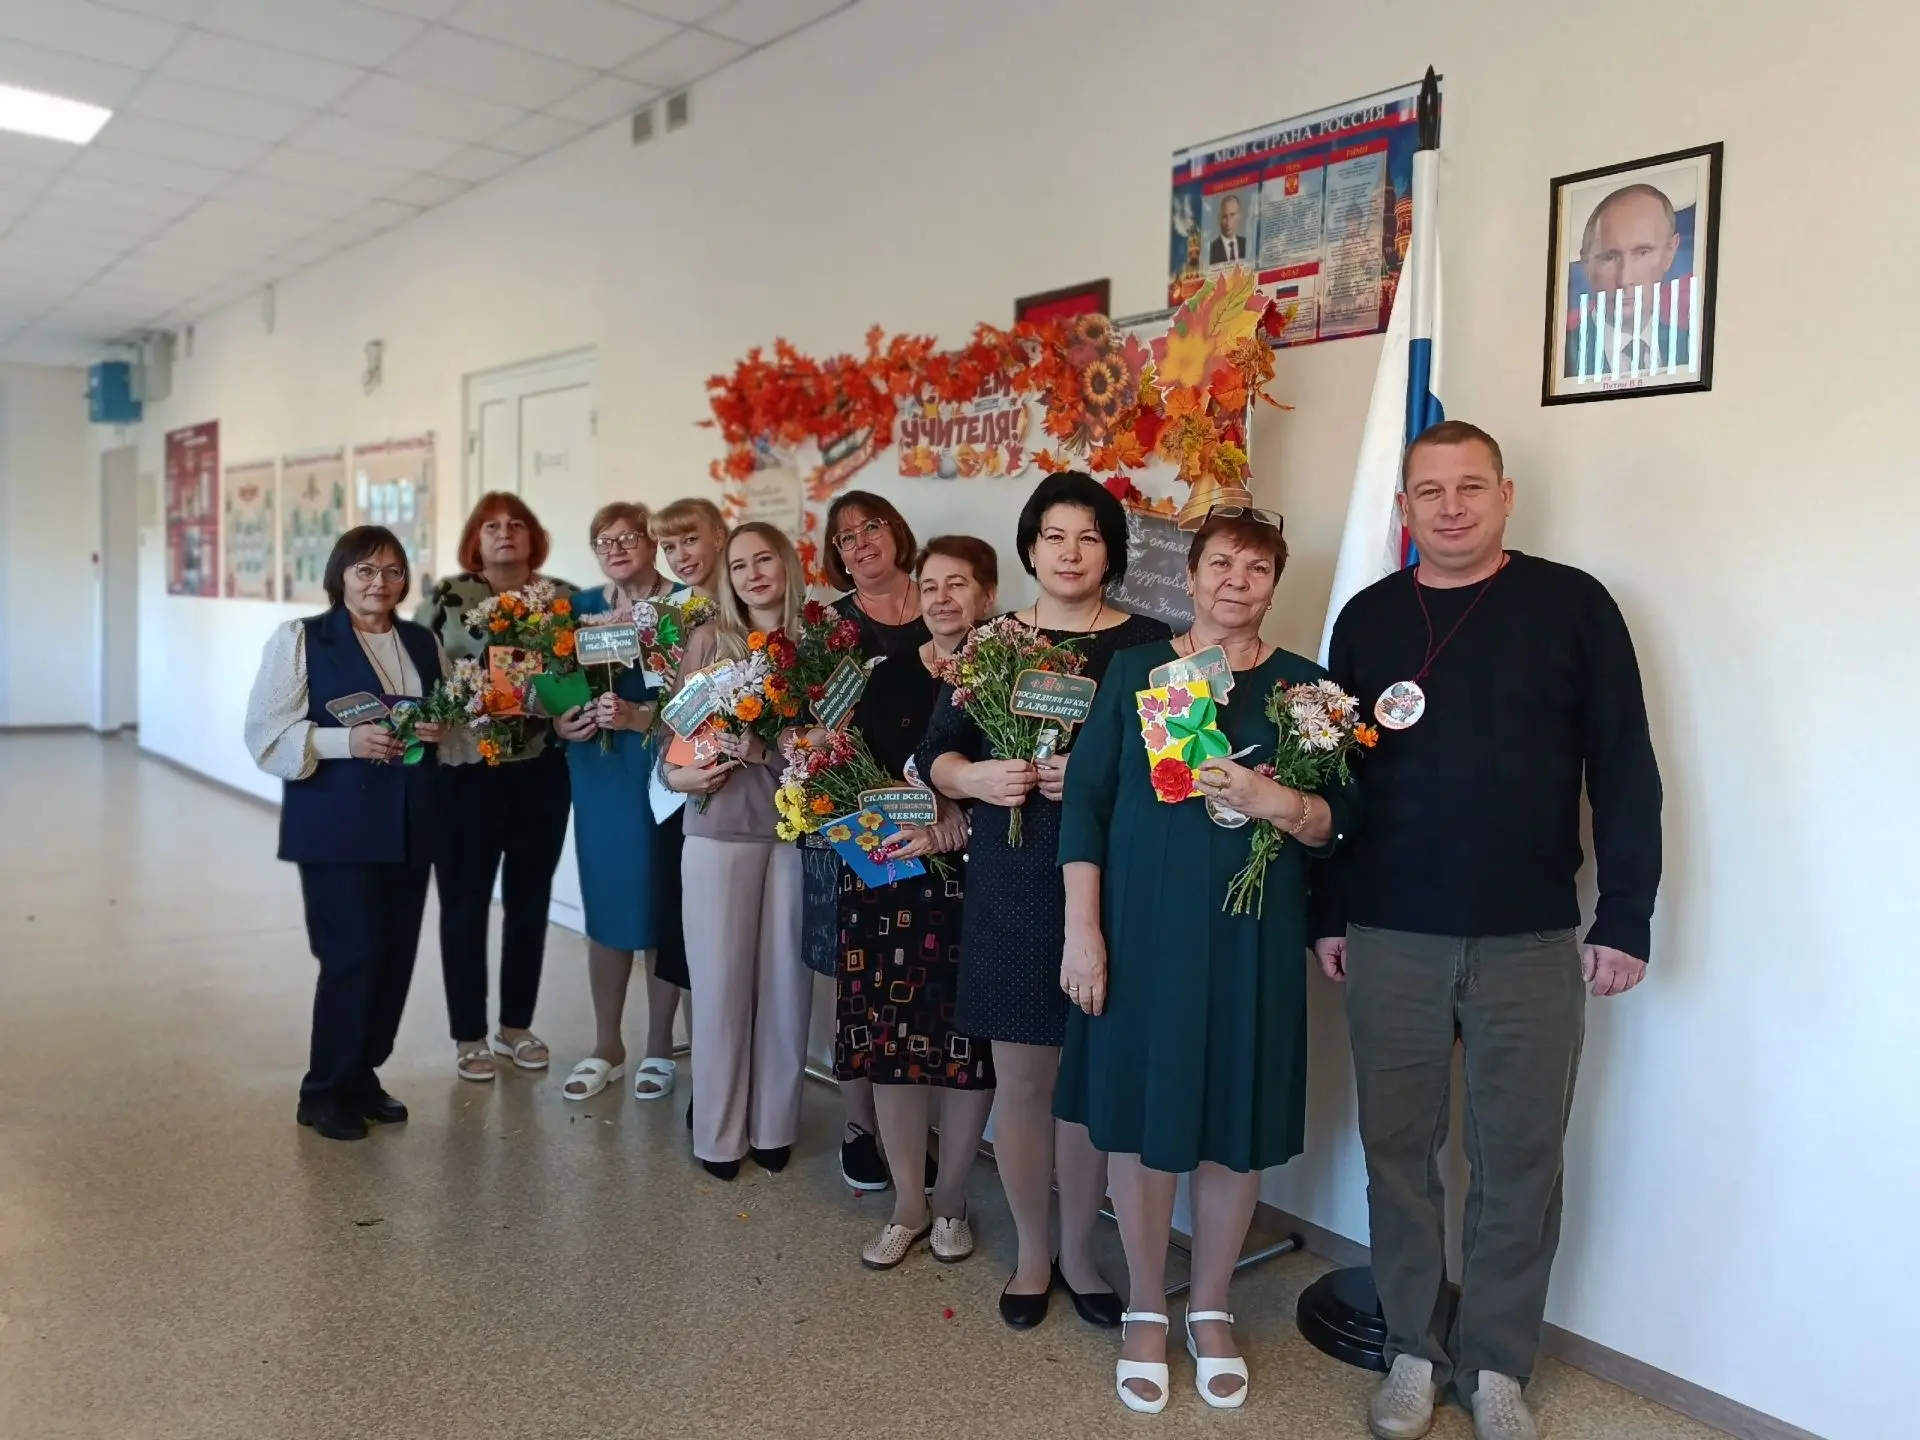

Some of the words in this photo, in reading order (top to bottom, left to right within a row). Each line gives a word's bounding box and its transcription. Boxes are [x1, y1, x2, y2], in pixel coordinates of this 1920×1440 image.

[1213, 145, 1247, 165] МОЯ
[1252, 124, 1313, 154] СТРАНА
[1319, 104, 1386, 136] РОССИЯ
[900, 407, 1023, 448] УЧИТЕЛЯ!
[1016, 700, 1024, 708] В
[1025, 702, 1083, 718] АЛФАВИТЕ!
[1063, 697, 1089, 708] БУКВА
[863, 793, 900, 803] СКАЖИ
[902, 793, 931, 801] ВСЕМ,
